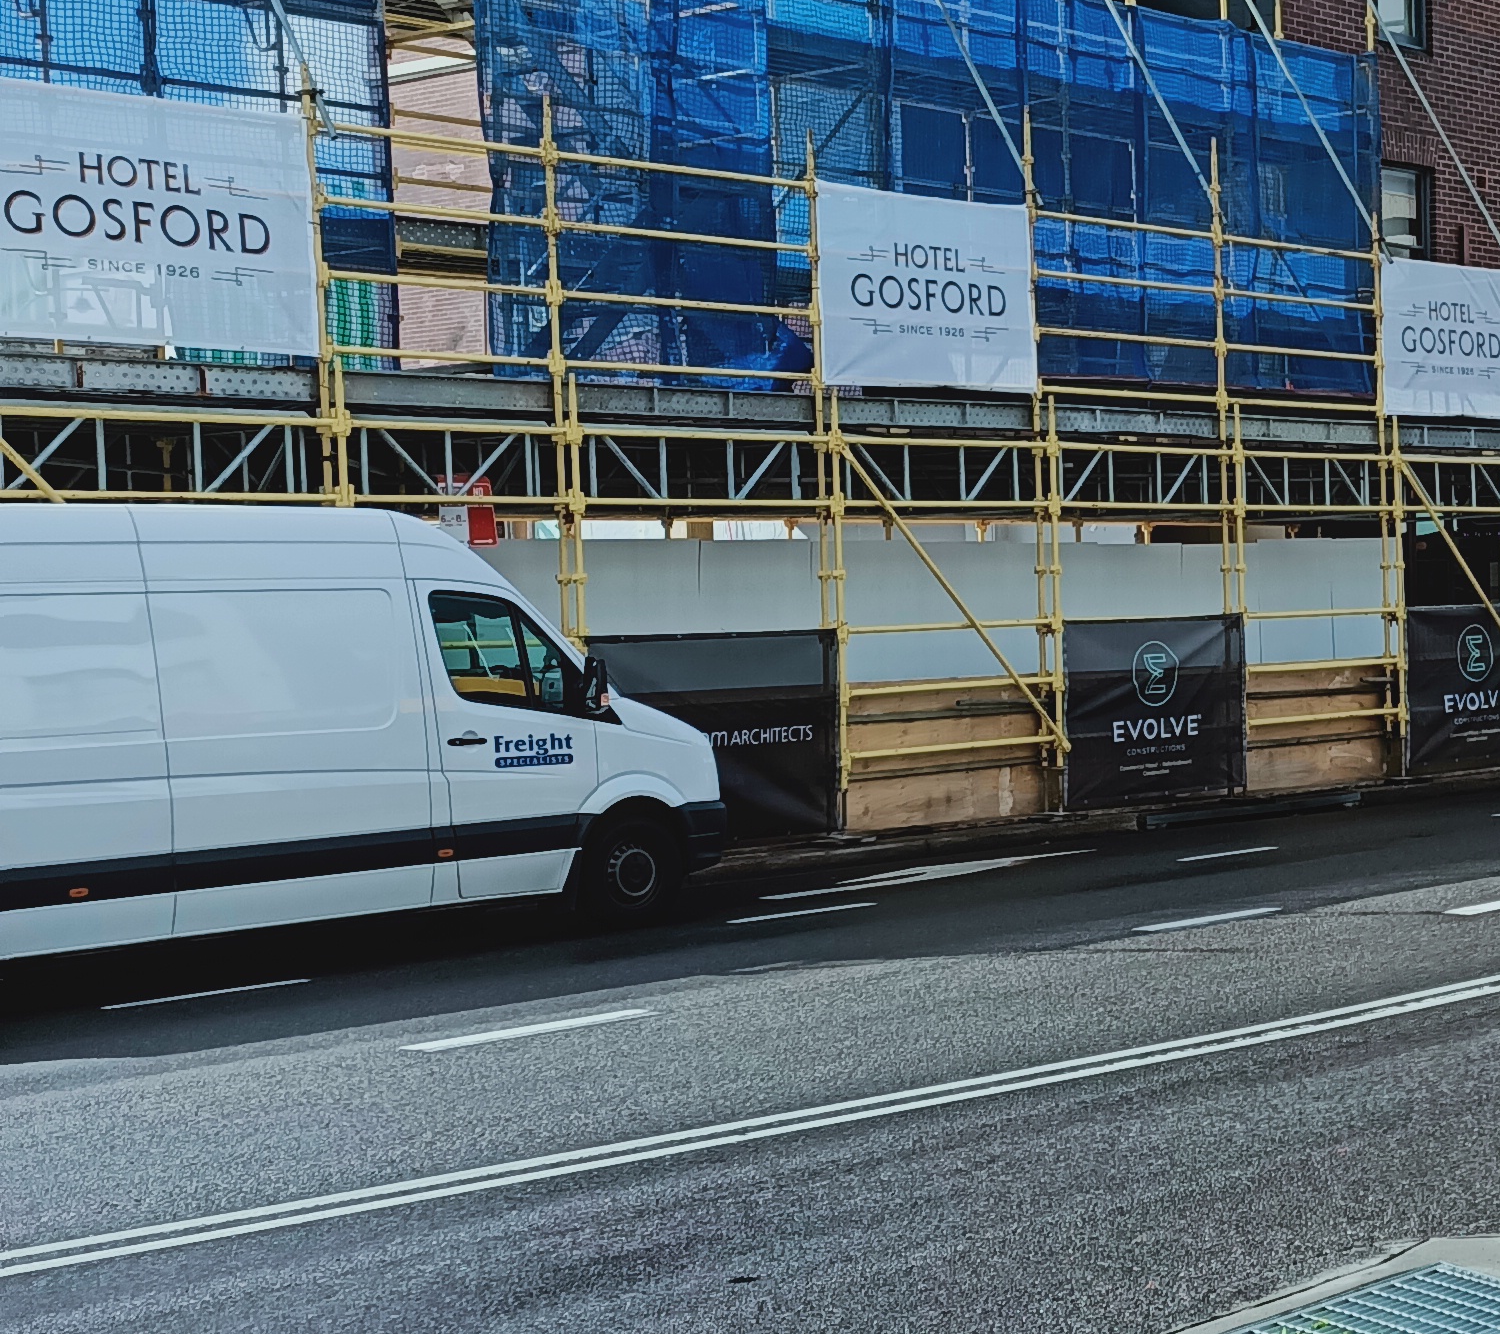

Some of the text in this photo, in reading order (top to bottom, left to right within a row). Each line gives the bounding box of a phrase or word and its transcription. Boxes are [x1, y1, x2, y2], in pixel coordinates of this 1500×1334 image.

[78, 151, 202, 196] HOTEL
[3, 189, 270, 255] GOSFORD
[87, 259, 200, 279] SINCE 1926
[894, 242, 966, 274] HOTEL
[851, 273, 1006, 317] GOSFORD
[1428, 300, 1475, 324] HOTEL
[899, 324, 934, 336] SINCE
[1431, 365, 1455, 375] SINCE
[730, 724, 814, 747] ARCHITECTS
[1112, 714, 1200, 743] EVOLVE
[493, 733, 574, 756] Freight
[1126, 743, 1186, 757] CONSTRUCTIONS
[499, 755, 570, 767] SPECIALISTS
